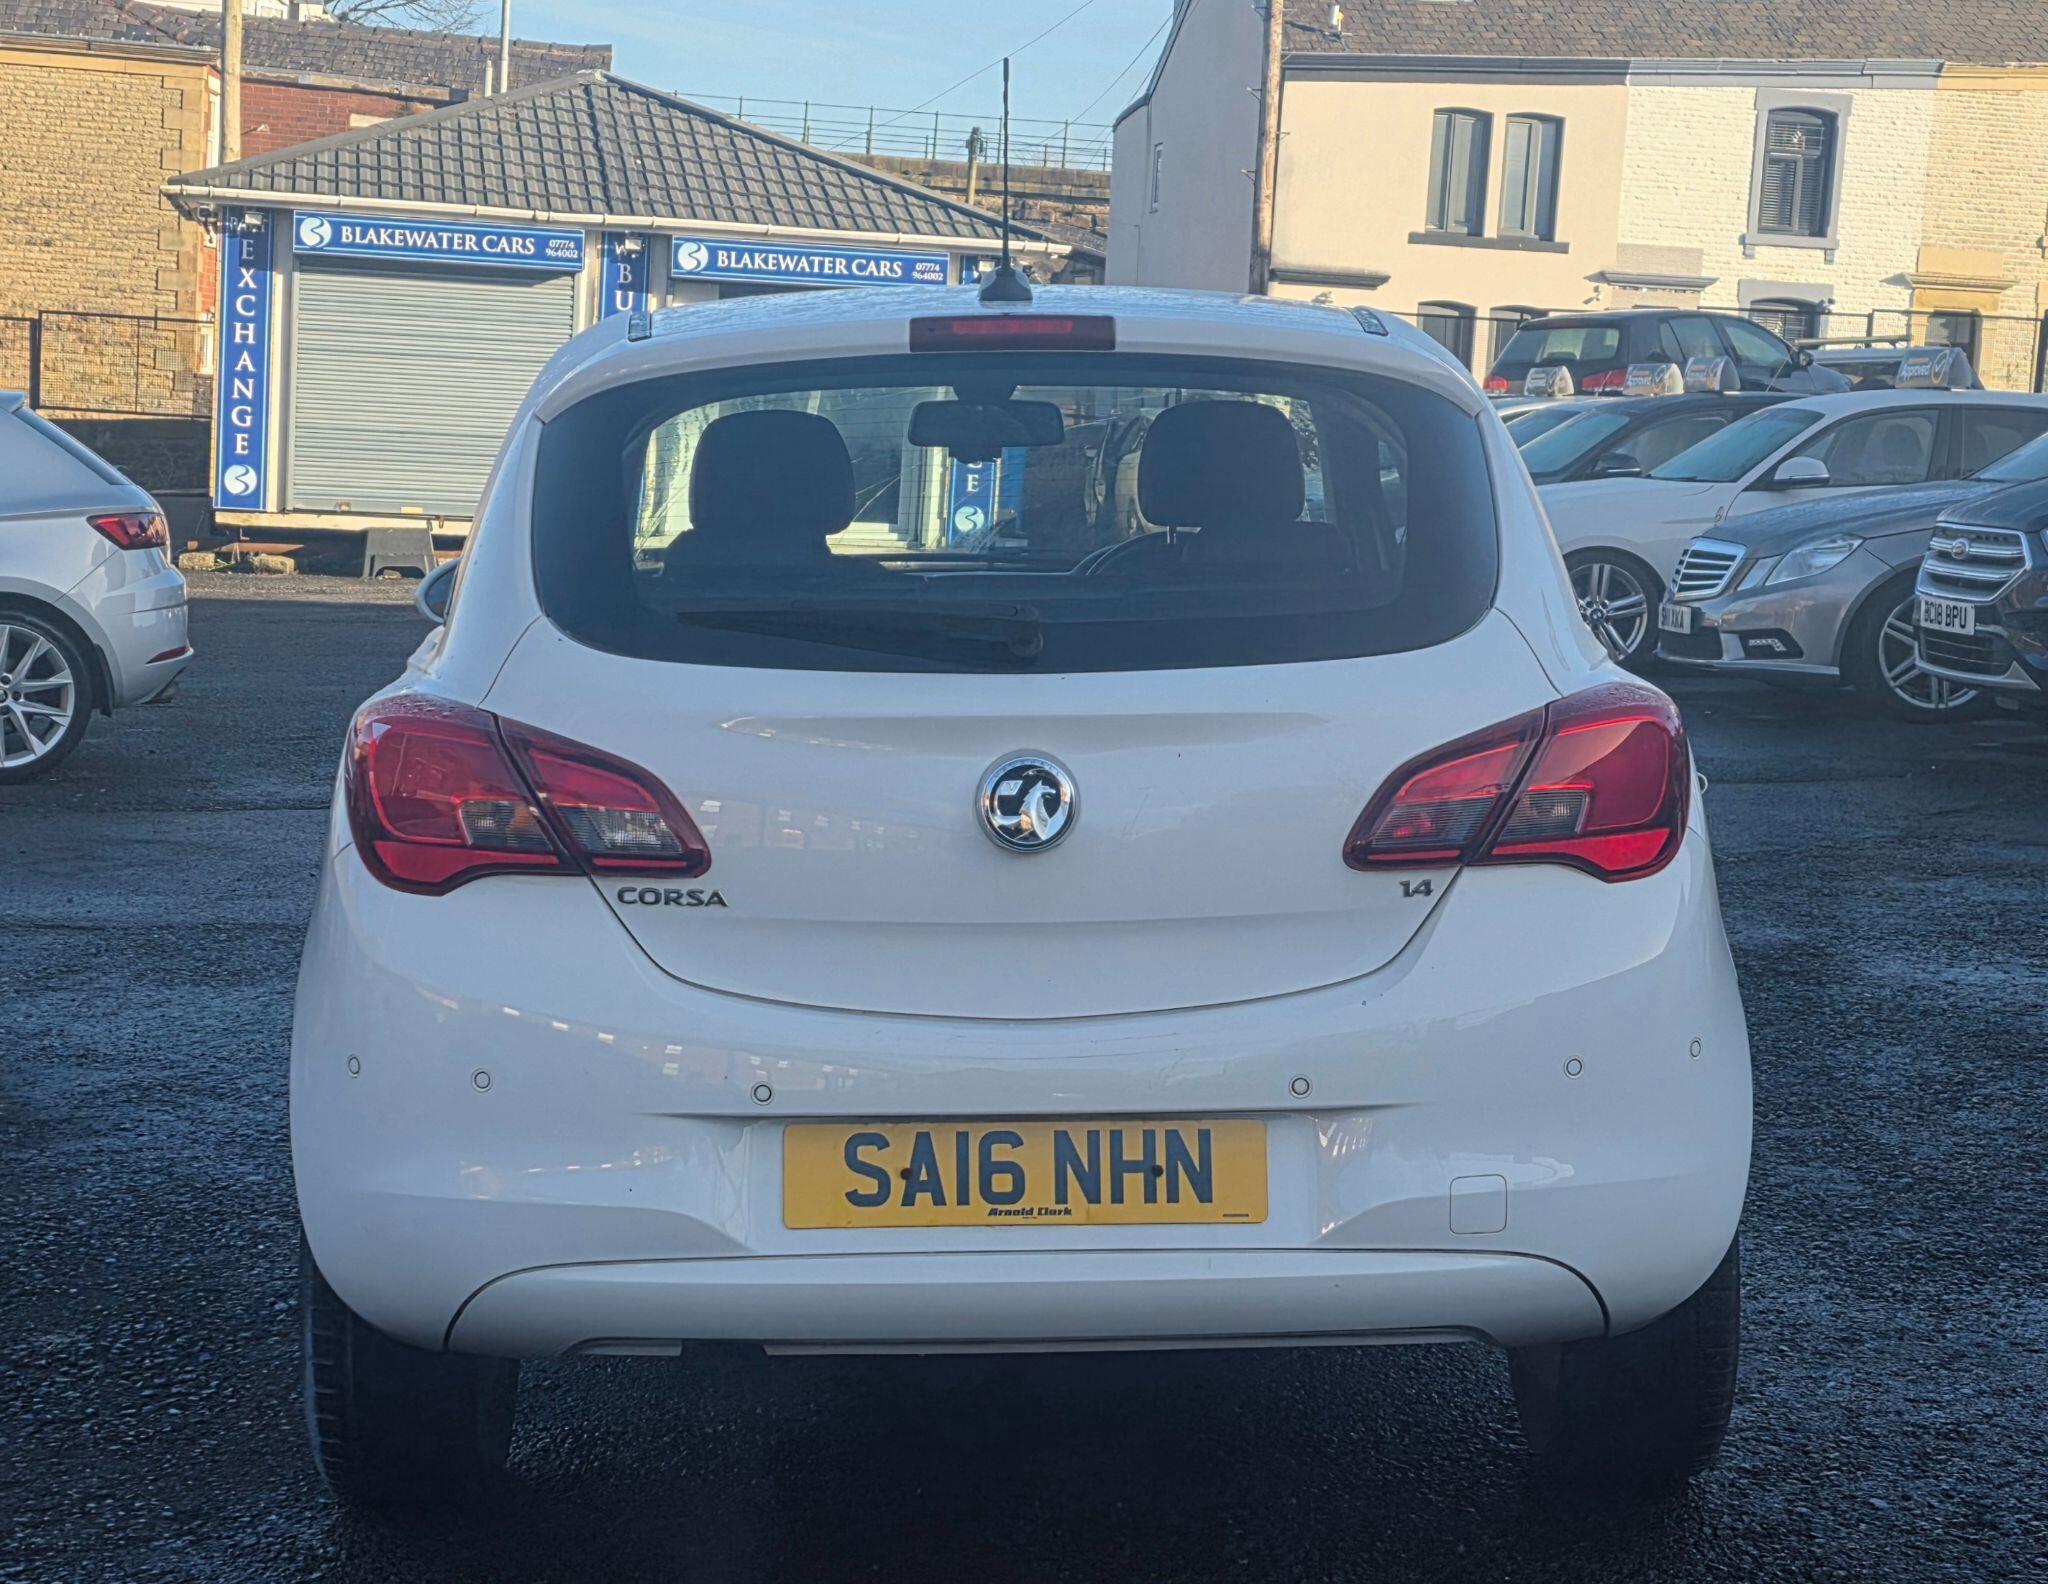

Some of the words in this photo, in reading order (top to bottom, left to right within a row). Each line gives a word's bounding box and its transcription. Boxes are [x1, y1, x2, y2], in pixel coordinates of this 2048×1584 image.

[230, 216, 269, 233] PAT
[341, 225, 478, 251] BLAKEWATER
[482, 235, 535, 255] CARS
[549, 239, 575, 250] 07774
[545, 248, 579, 259] 964002
[717, 250, 848, 274] BLAKEWATER
[851, 258, 902, 278] CARS
[911, 271, 944, 281] 964002
[915, 262, 940, 272] 07774
[615, 263, 635, 311] BU
[231, 239, 256, 454] EXCHANGE
[1945, 604, 1967, 629] BPU
[617, 886, 728, 907] CORSA
[844, 1130, 1026, 1208] SA16
[1053, 1128, 1214, 1205] NHN
[987, 1207, 1035, 1216] Arnold
[1037, 1206, 1073, 1216] Clark
